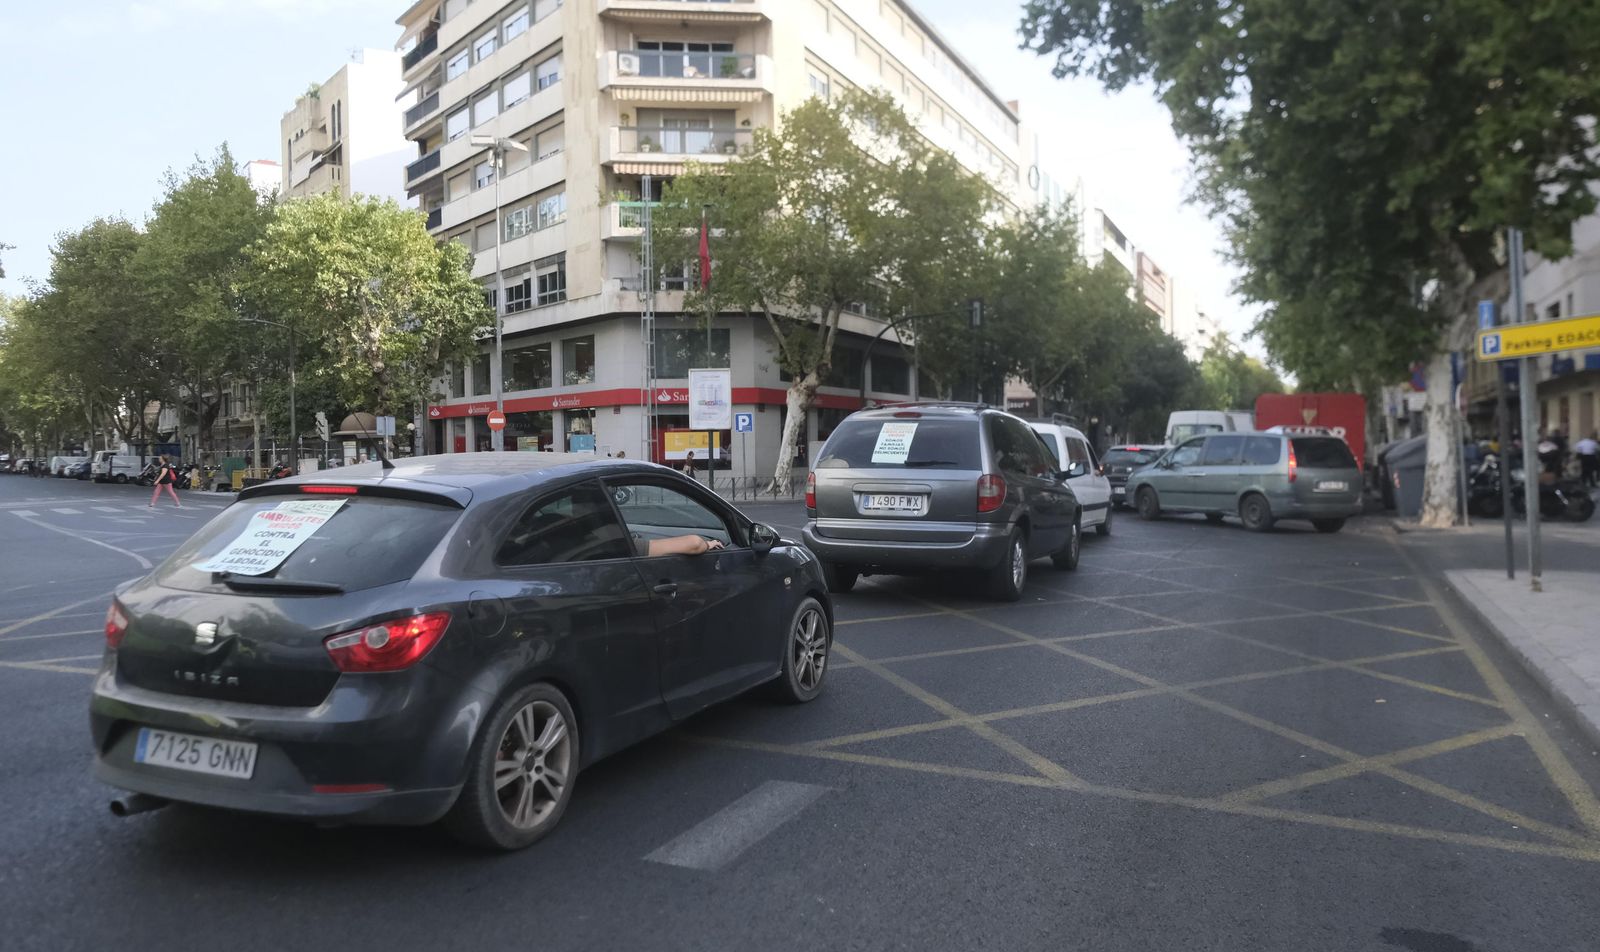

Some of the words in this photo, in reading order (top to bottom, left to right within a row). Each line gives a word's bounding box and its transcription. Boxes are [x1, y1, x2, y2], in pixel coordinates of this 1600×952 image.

[1485, 337, 1497, 353] P
[559, 397, 581, 406] Santander
[738, 415, 750, 431] P
[872, 496, 896, 506] 1490
[899, 496, 919, 507] FWX
[254, 530, 297, 539] CONTRA
[259, 539, 271, 547] EL
[229, 548, 285, 557] GENOCIDIO
[221, 557, 269, 566] LABORAL
[174, 669, 239, 685] IBIZA
[151, 733, 201, 765] 7125
[208, 743, 254, 773] GNN
